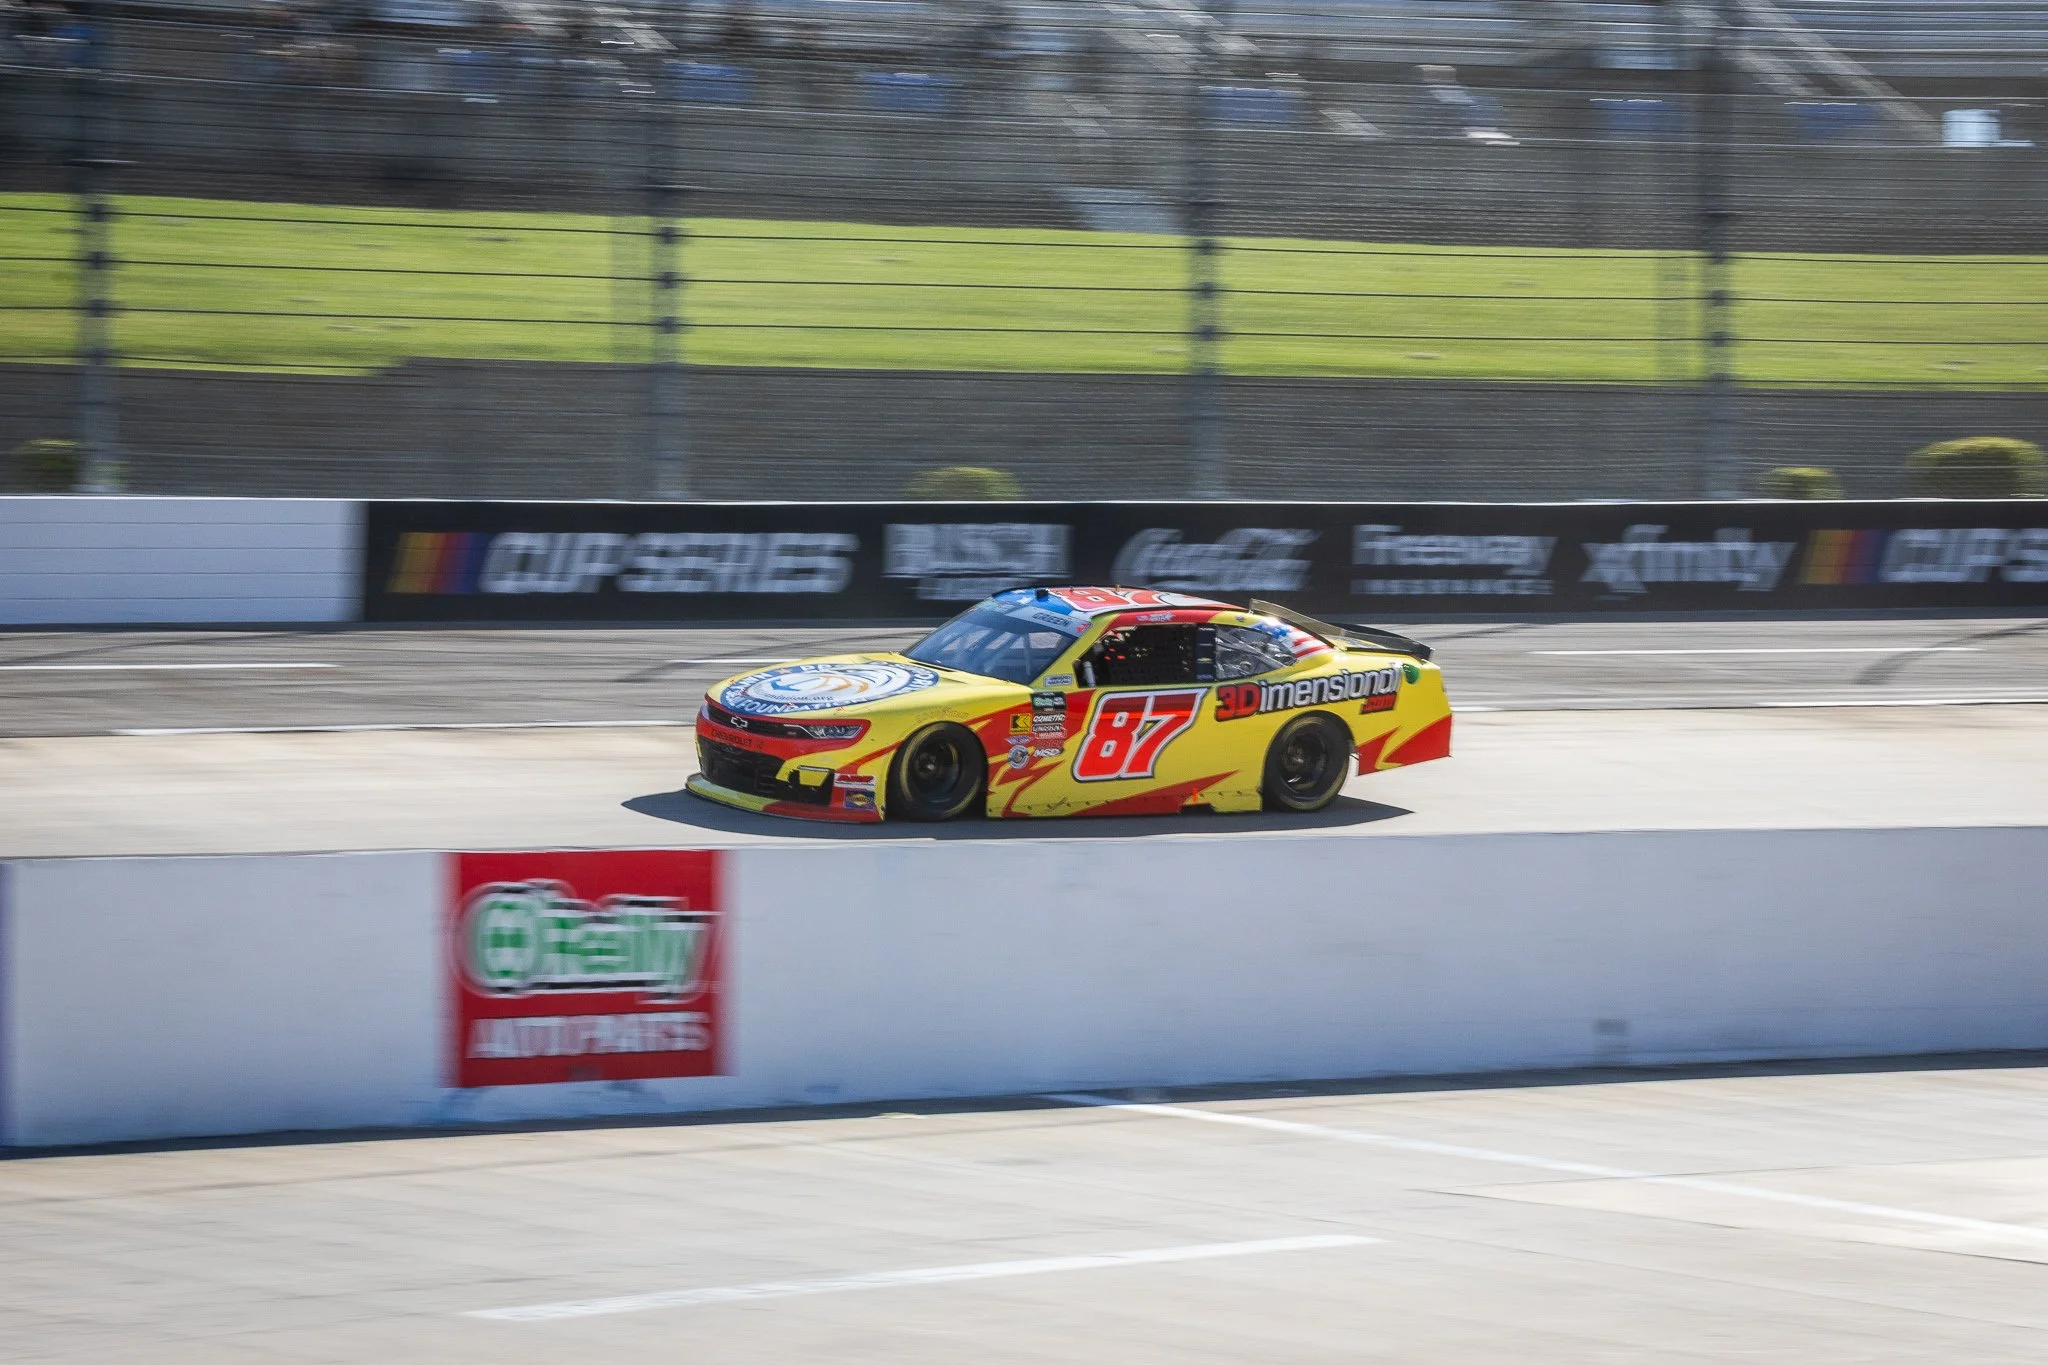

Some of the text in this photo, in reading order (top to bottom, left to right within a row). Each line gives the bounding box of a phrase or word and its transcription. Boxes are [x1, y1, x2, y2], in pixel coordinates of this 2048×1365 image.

[479, 531, 858, 593] CUP SERIES
[1215, 665, 1401, 722] 3Dimensional
[1071, 687, 1211, 783] 87
